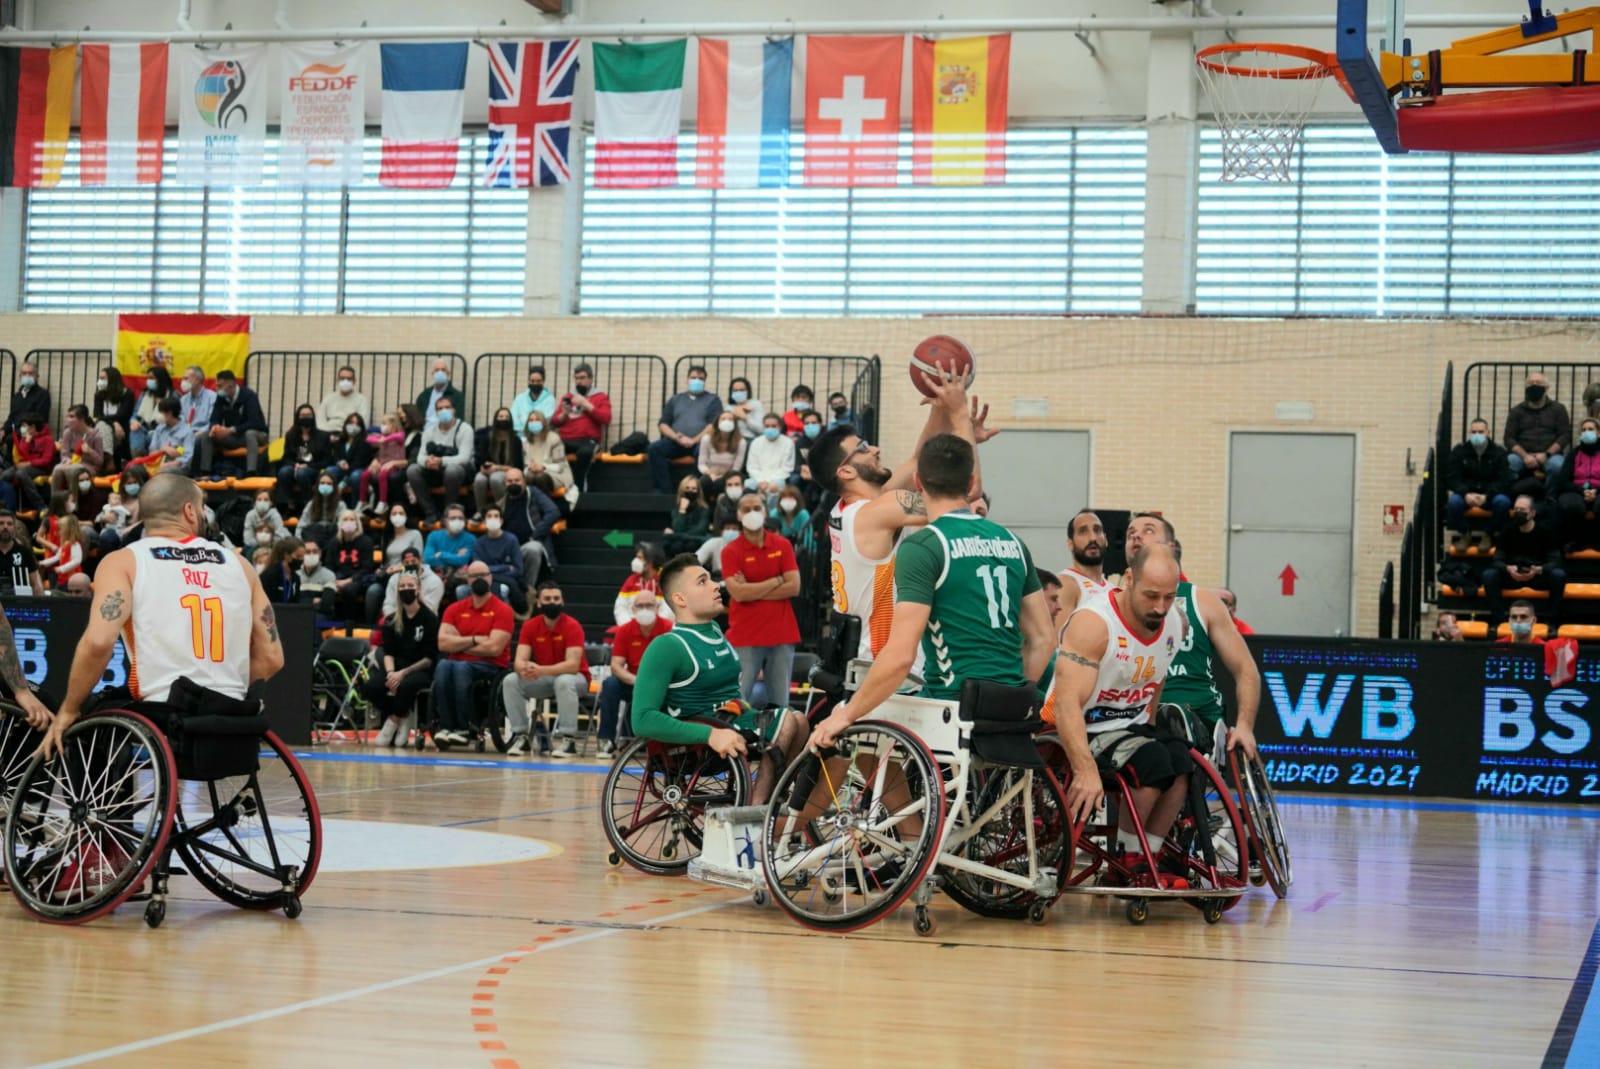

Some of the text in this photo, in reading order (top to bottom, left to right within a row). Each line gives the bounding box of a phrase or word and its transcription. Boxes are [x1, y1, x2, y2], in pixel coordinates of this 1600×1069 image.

[288, 75, 358, 92] FEDDF
[180, 593, 225, 663] 11
[976, 564, 1014, 629] 11
[1264, 672, 1416, 742] WB
[1483, 686, 1591, 755] BS
[1347, 763, 1421, 791] 2021
[1475, 769, 1571, 798] MADRID
